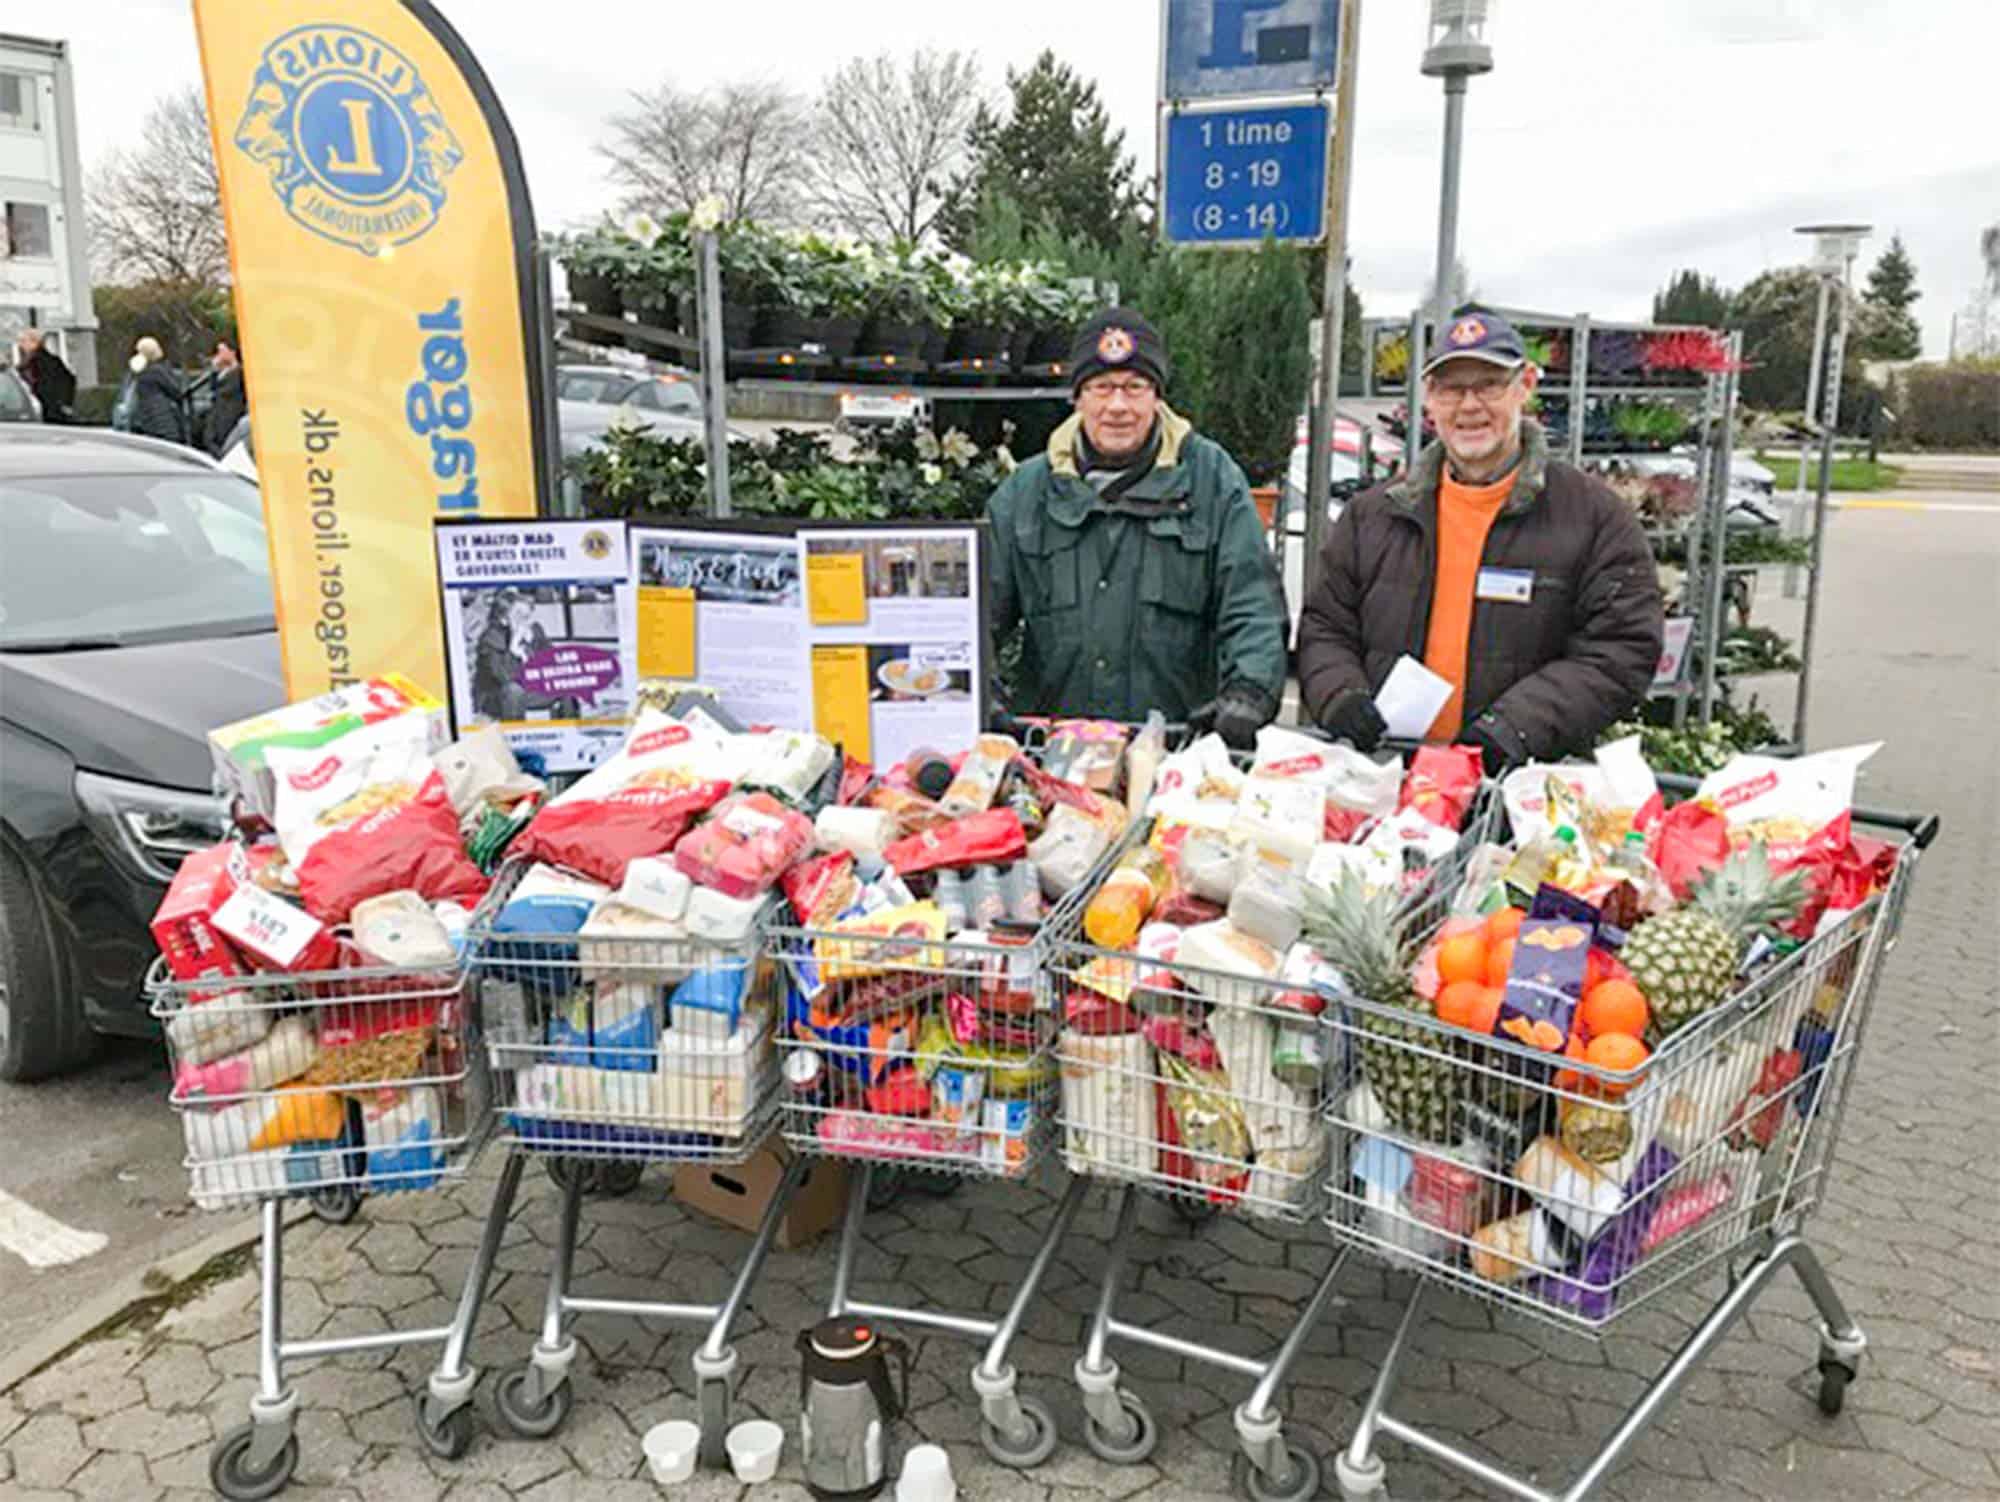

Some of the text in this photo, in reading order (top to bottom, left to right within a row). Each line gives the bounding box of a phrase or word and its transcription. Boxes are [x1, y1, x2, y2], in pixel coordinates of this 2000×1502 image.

[1200, 119, 1293, 147] 1 time
[1205, 161, 1224, 189] 8
[1247, 159, 1281, 188] 19
